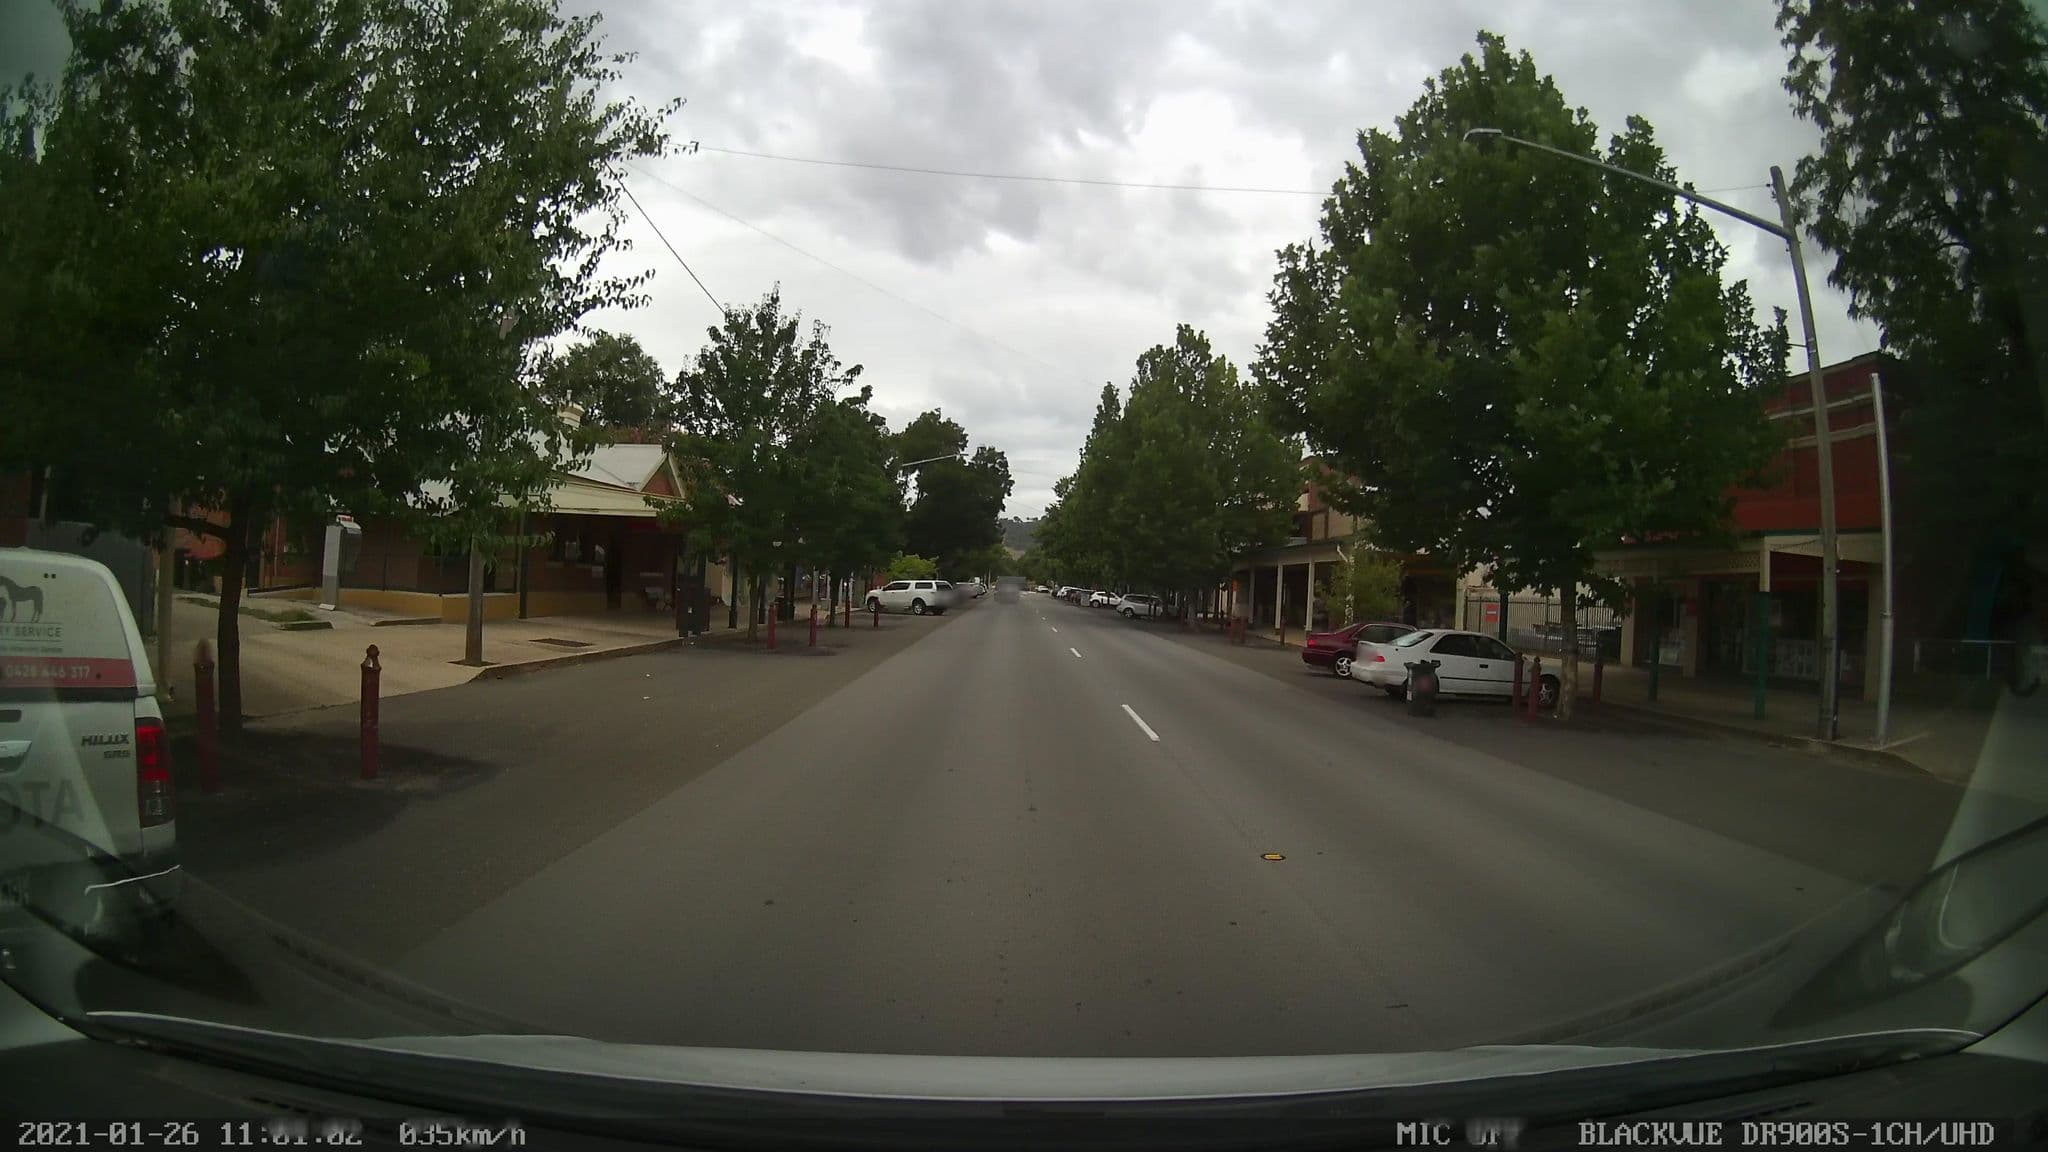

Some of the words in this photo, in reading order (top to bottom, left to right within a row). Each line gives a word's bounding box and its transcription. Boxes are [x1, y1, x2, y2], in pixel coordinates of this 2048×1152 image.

[14, 626, 62, 637] SERVICE
[71, 664, 90, 680] 317
[81, 734, 129, 746] HILUX
